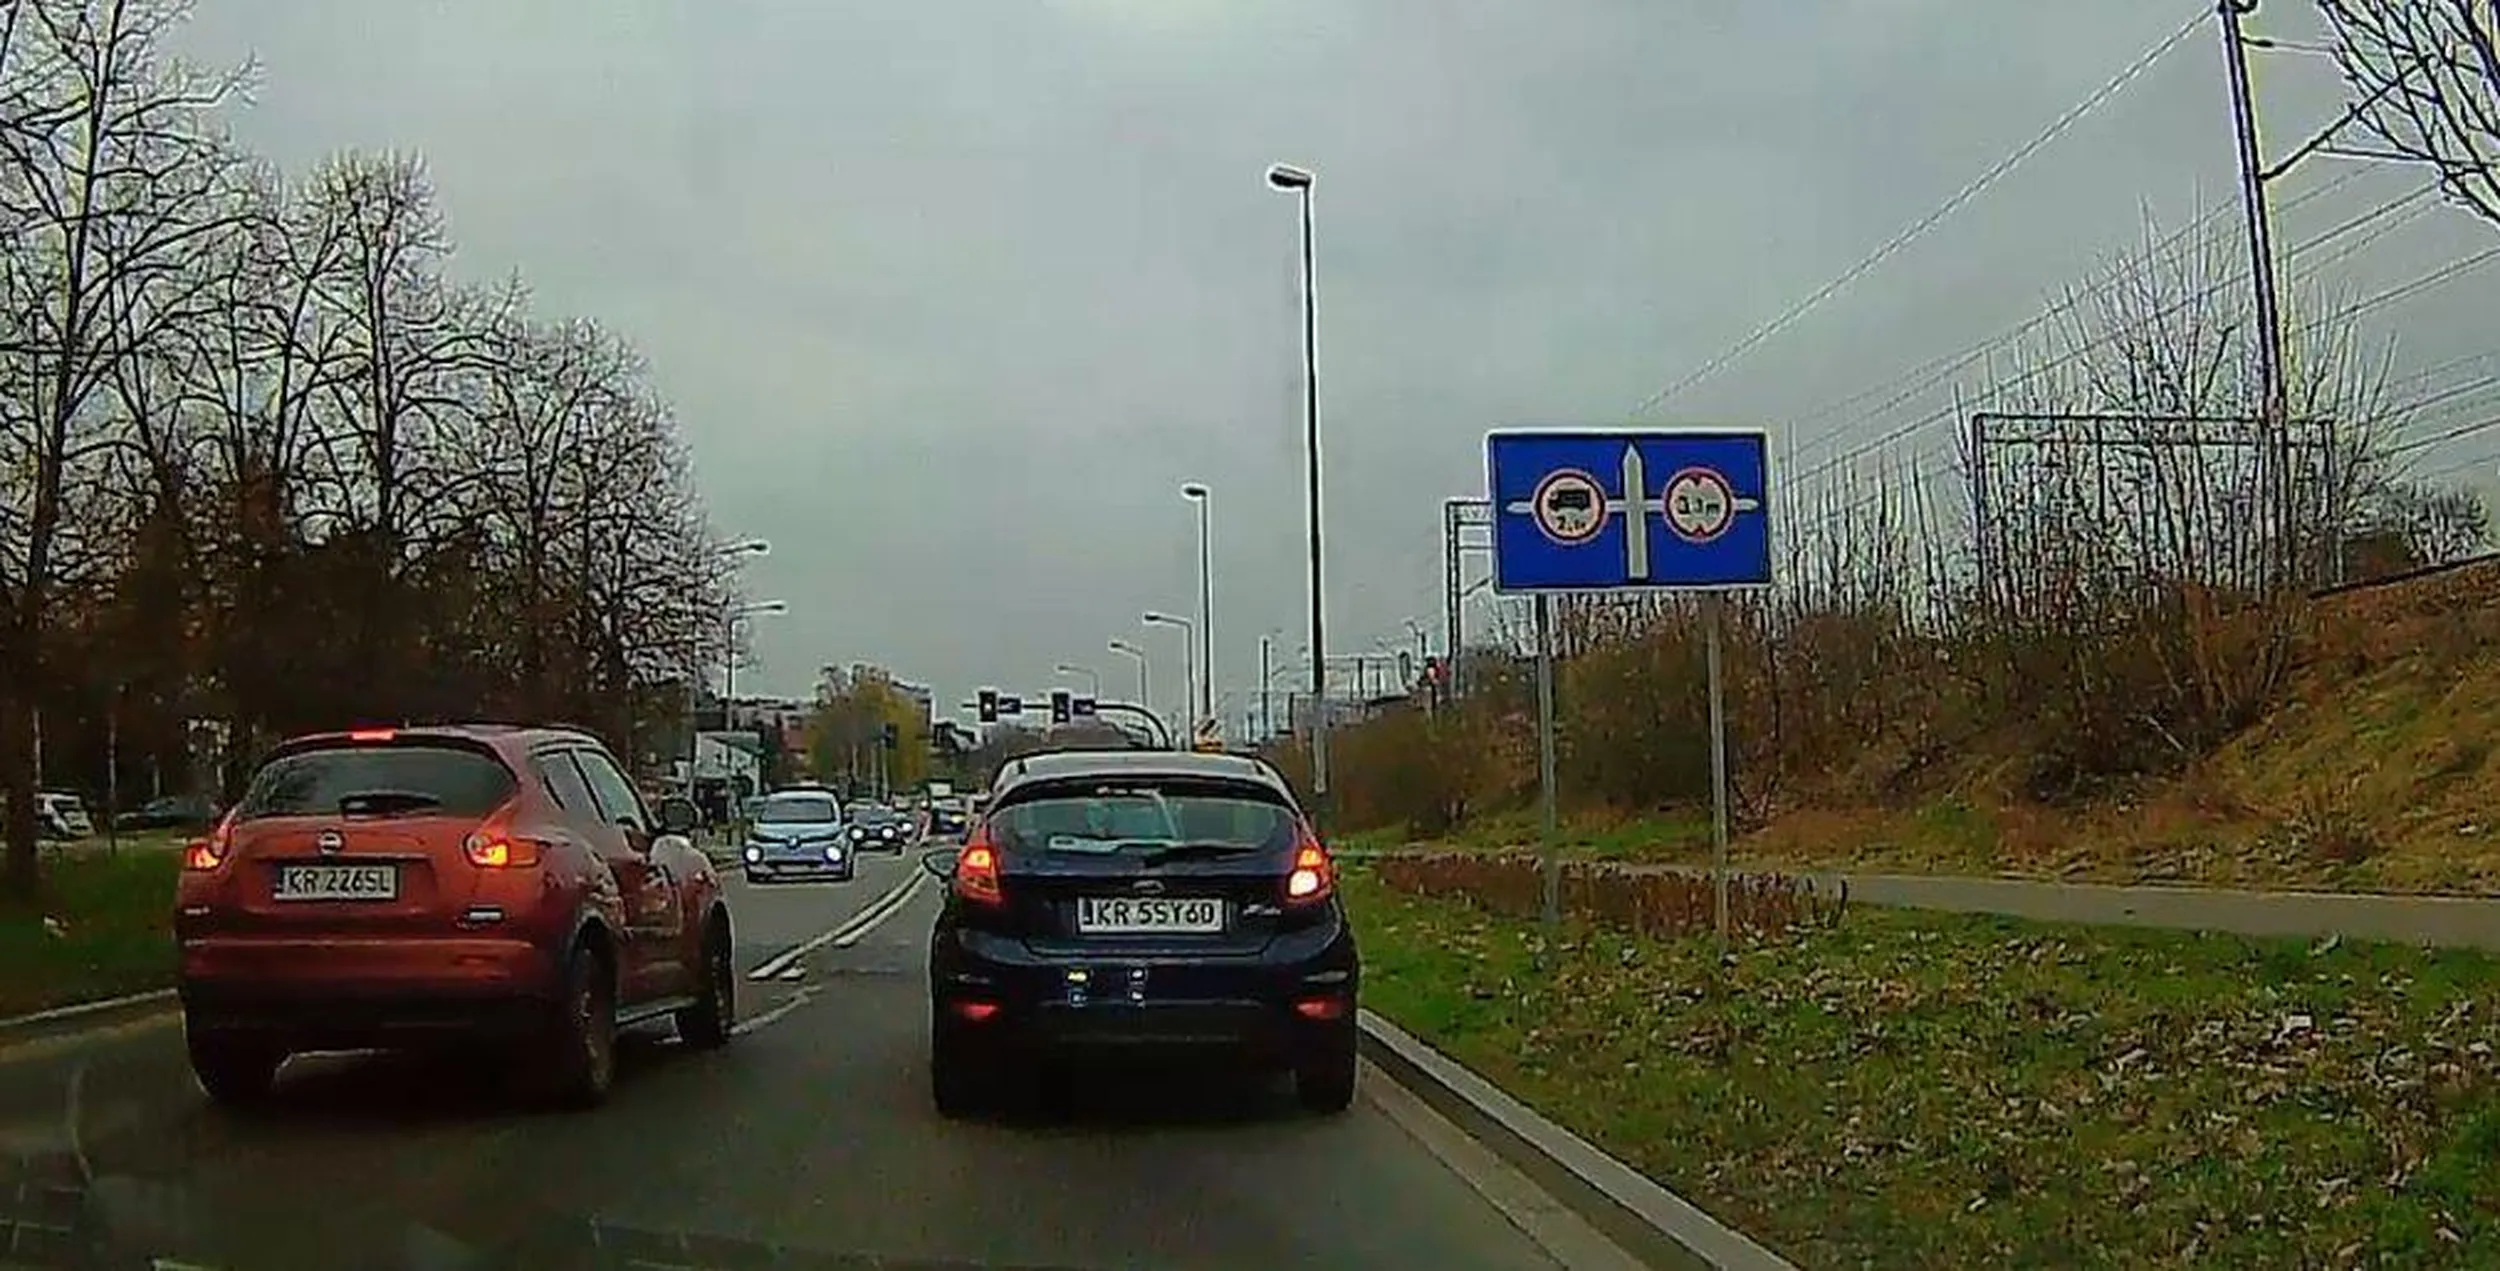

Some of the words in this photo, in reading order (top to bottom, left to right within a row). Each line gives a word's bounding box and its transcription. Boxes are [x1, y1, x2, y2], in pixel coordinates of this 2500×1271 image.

[288, 869, 319, 893] KR
[325, 869, 391, 892] 226SL
[1098, 901, 1130, 925] KR
